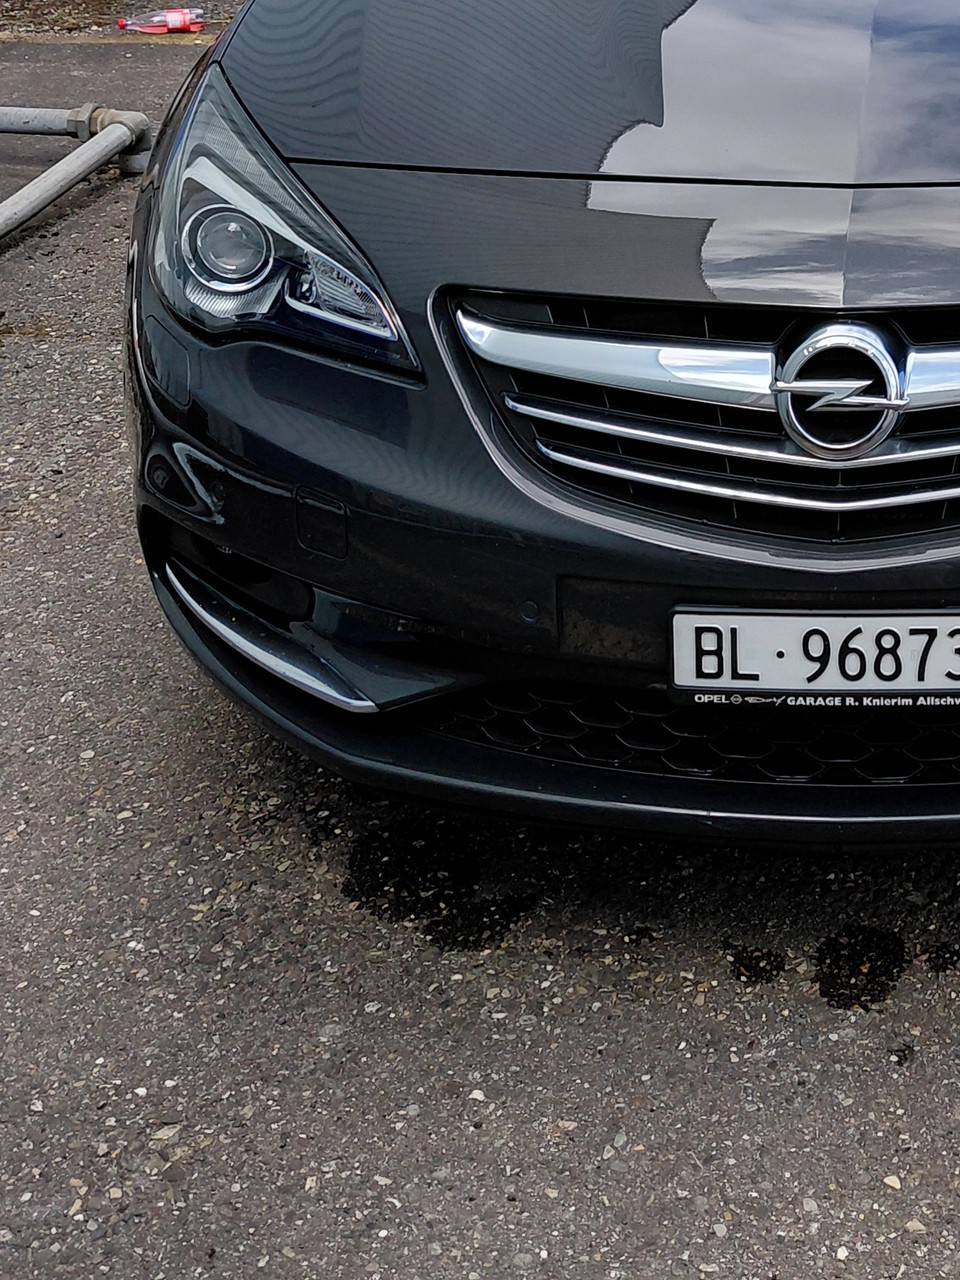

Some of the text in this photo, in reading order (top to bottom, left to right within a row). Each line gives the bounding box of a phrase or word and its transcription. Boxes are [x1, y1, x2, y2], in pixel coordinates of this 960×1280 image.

[694, 626, 760, 681] BL
[694, 694, 730, 703] OPEL
[787, 696, 842, 706] GARAGE
[845, 697, 859, 706] R.
[863, 696, 913, 706] Knierim
